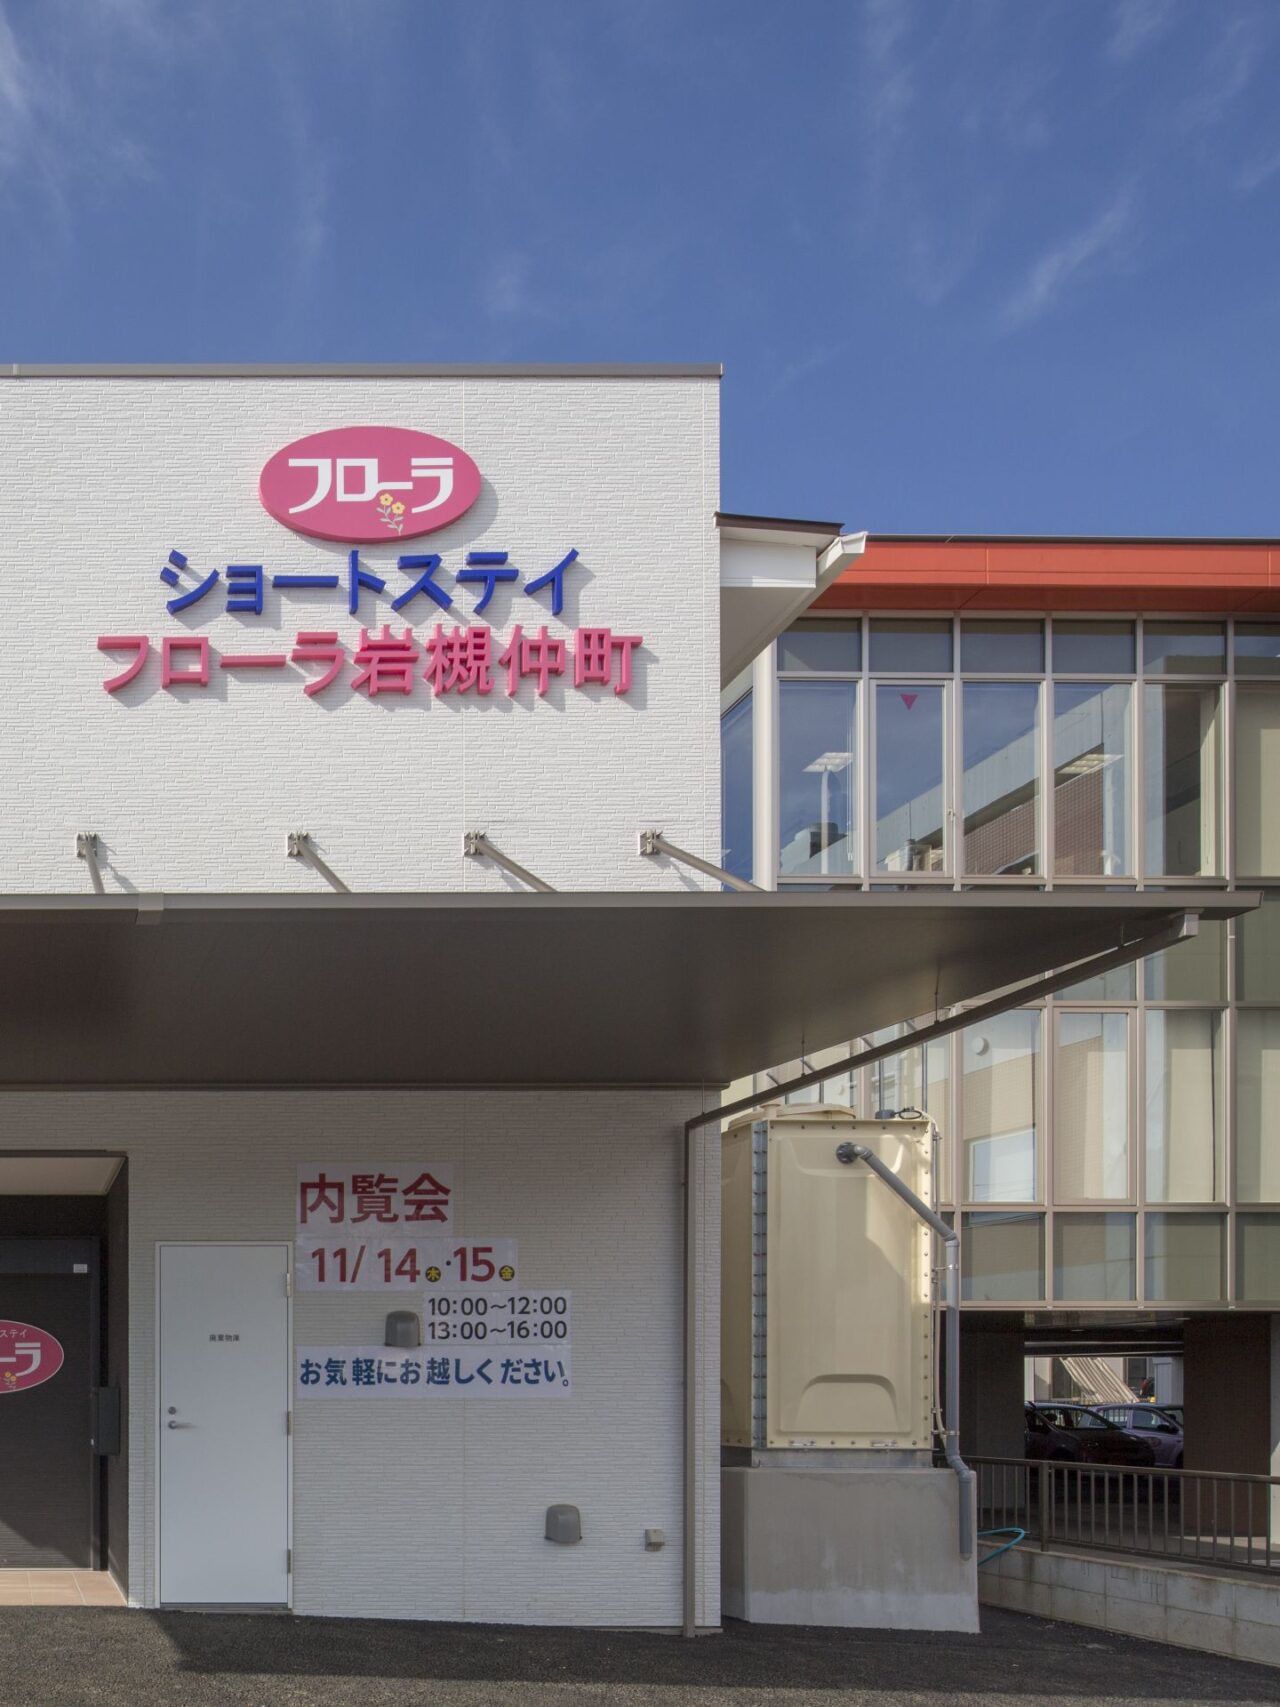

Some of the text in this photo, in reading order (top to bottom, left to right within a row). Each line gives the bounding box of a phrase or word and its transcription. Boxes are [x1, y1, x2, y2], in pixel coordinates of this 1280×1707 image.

[288, 457, 454, 514] フローラ
[160, 549, 580, 616] ショートステイ
[97, 623, 643, 696] フローラ岩槻仲町
[300, 1172, 452, 1224] 内覧会
